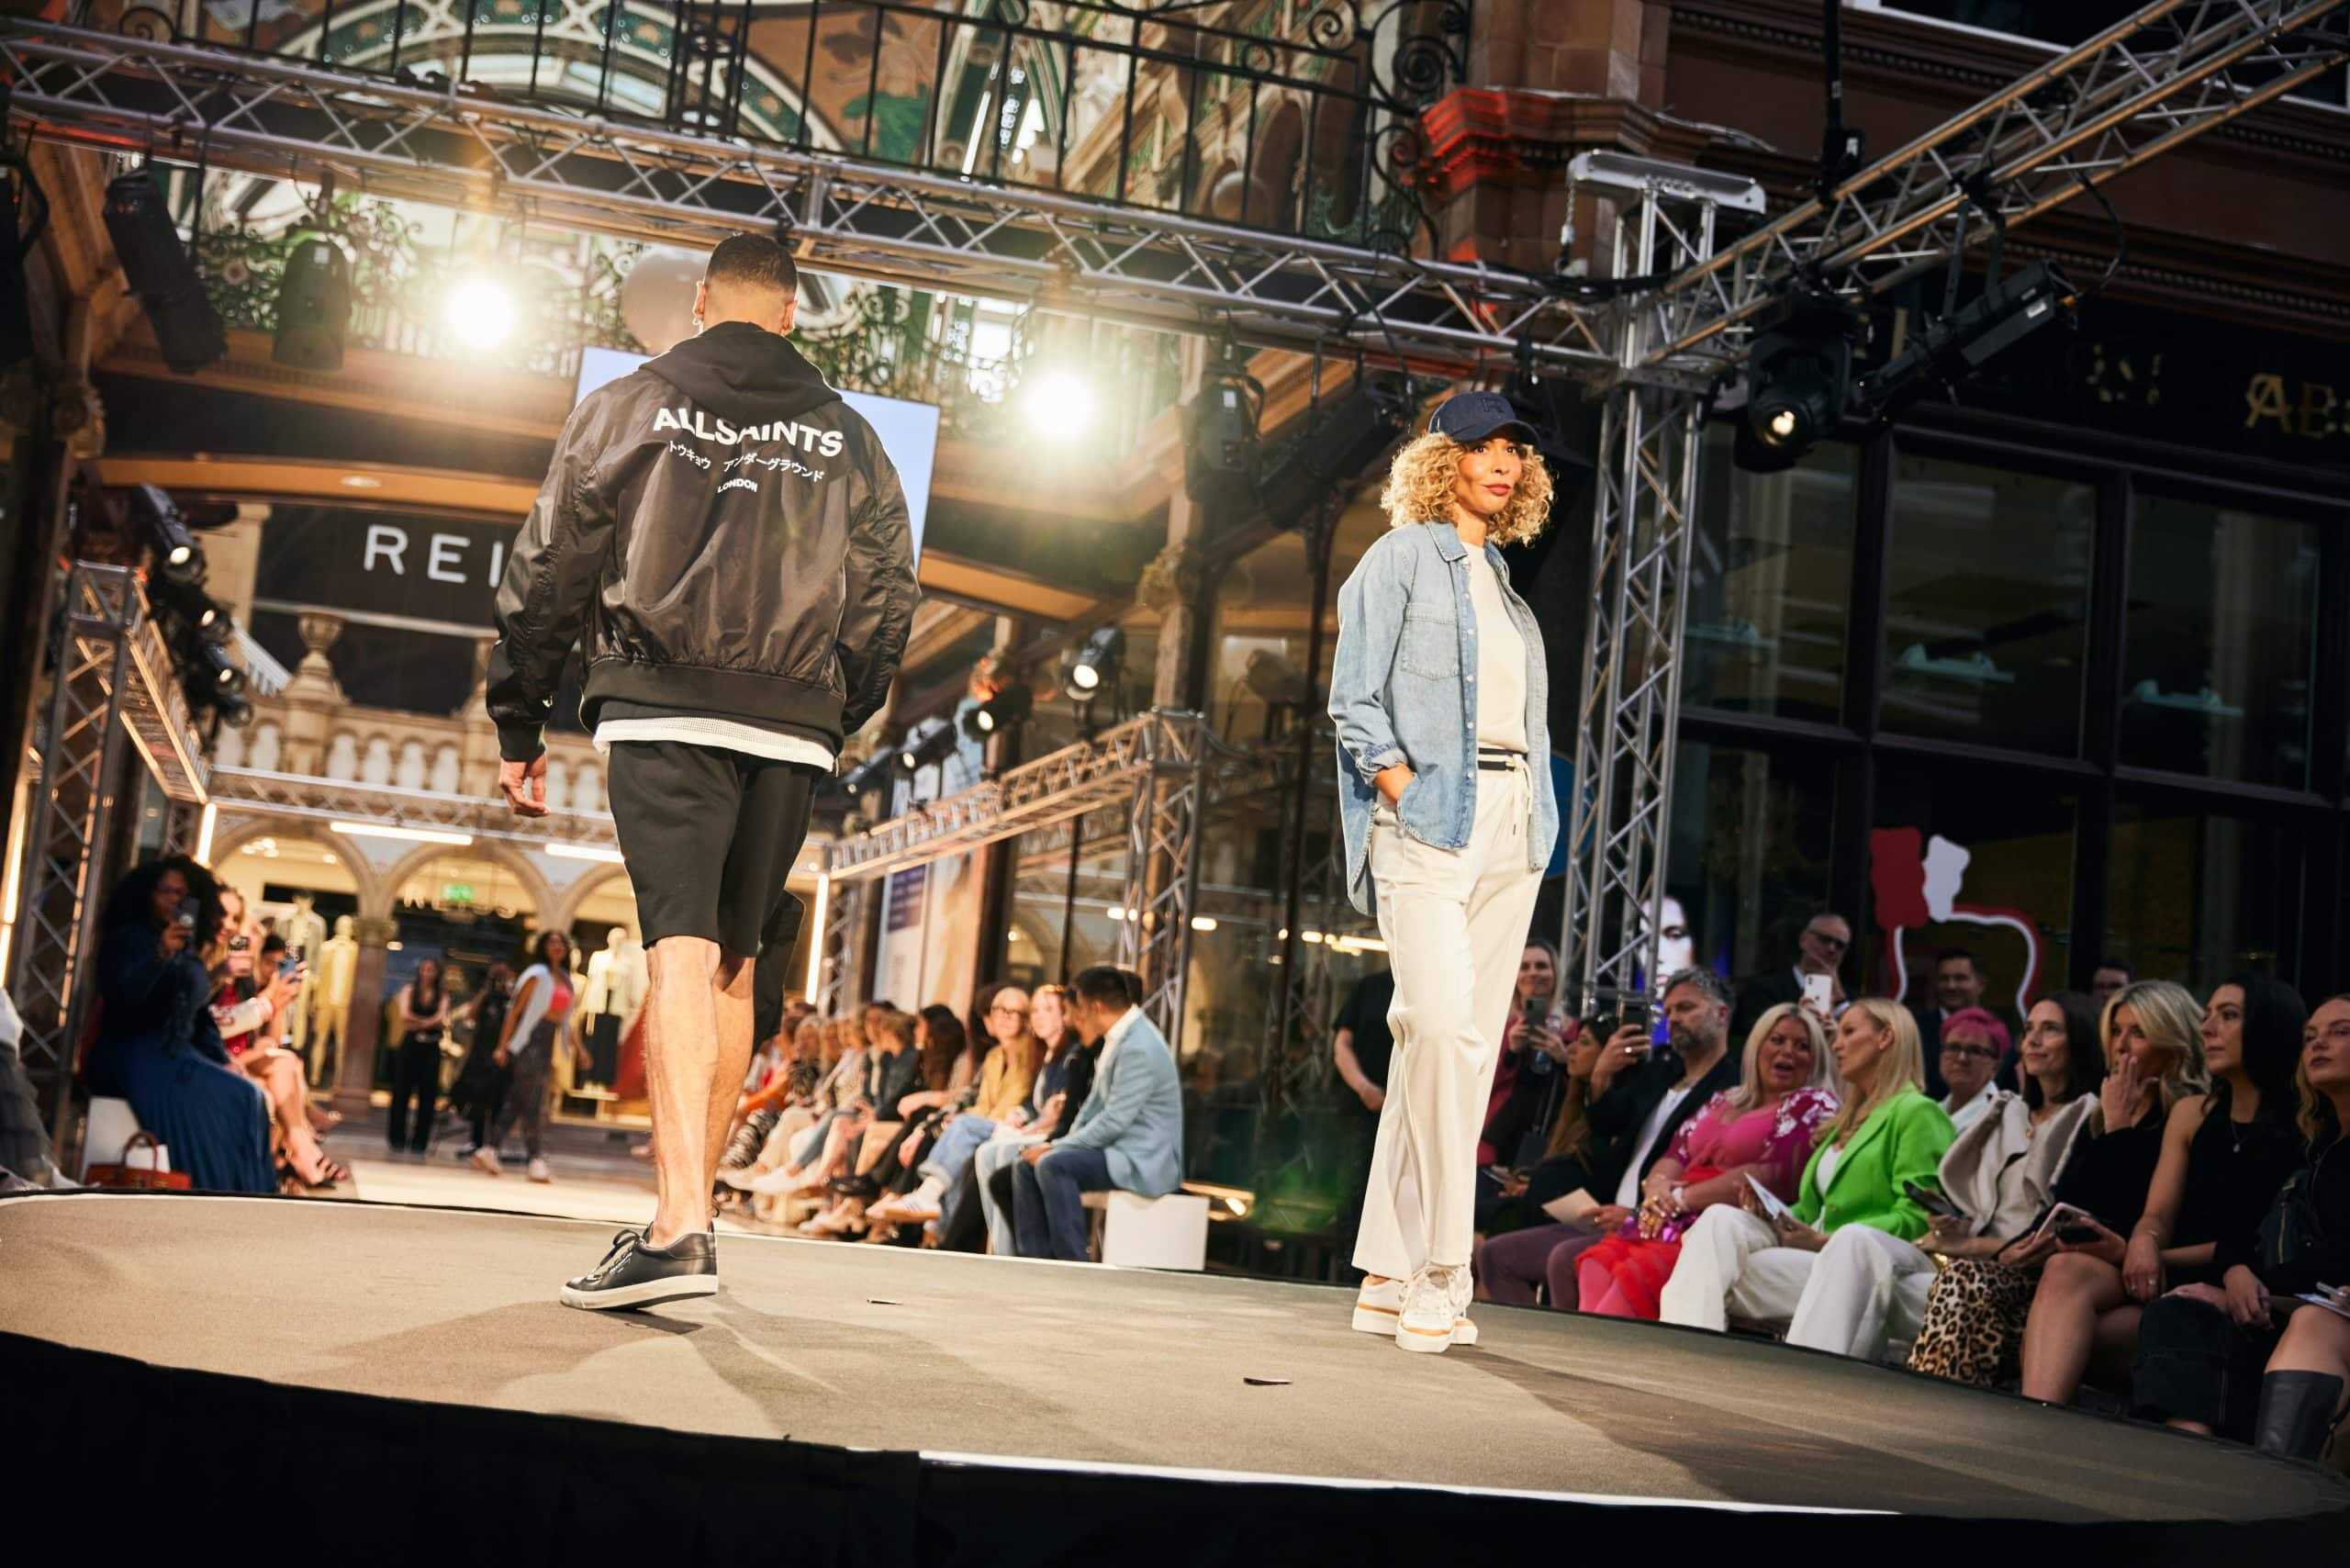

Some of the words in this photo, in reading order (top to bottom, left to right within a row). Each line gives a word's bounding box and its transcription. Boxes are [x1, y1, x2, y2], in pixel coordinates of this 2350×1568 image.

[653, 408, 844, 457] ALLSAINTS
[717, 477, 758, 494] LONDON
[364, 523, 503, 588] REI
